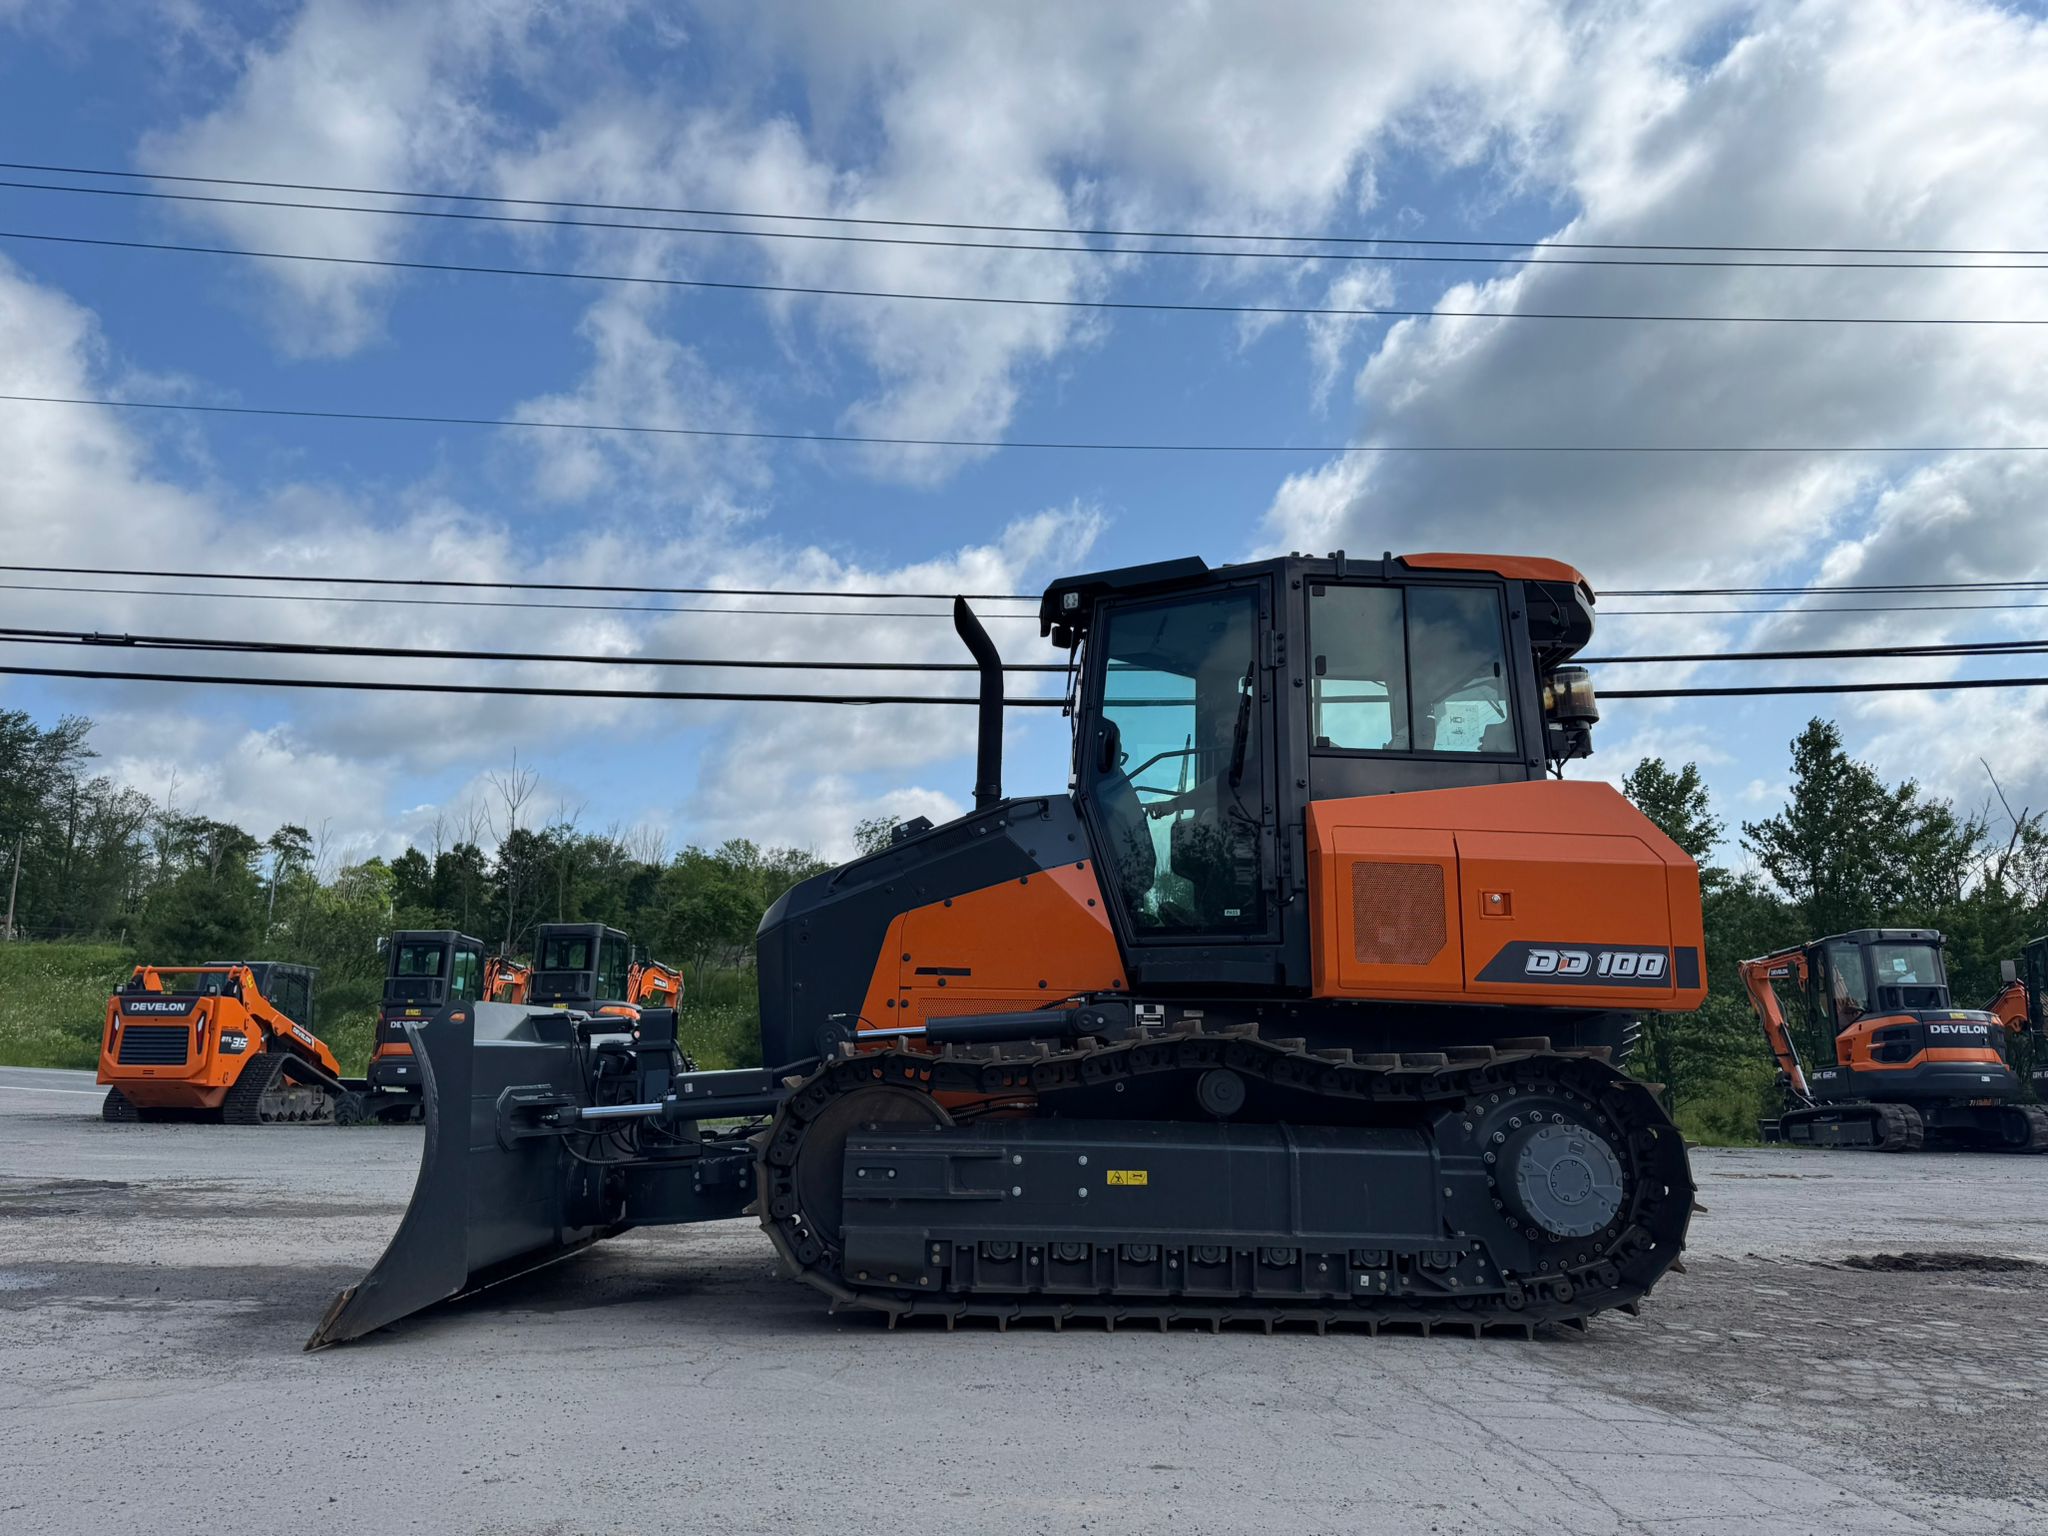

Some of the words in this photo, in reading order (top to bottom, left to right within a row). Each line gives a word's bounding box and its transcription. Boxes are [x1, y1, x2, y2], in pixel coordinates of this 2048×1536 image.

[1525, 949, 1593, 976] DD
[1596, 951, 1668, 980] 100
[130, 1002, 186, 1011] DEVELON
[1930, 1024, 1988, 1034] DEVELON
[230, 1037, 248, 1049] 35
